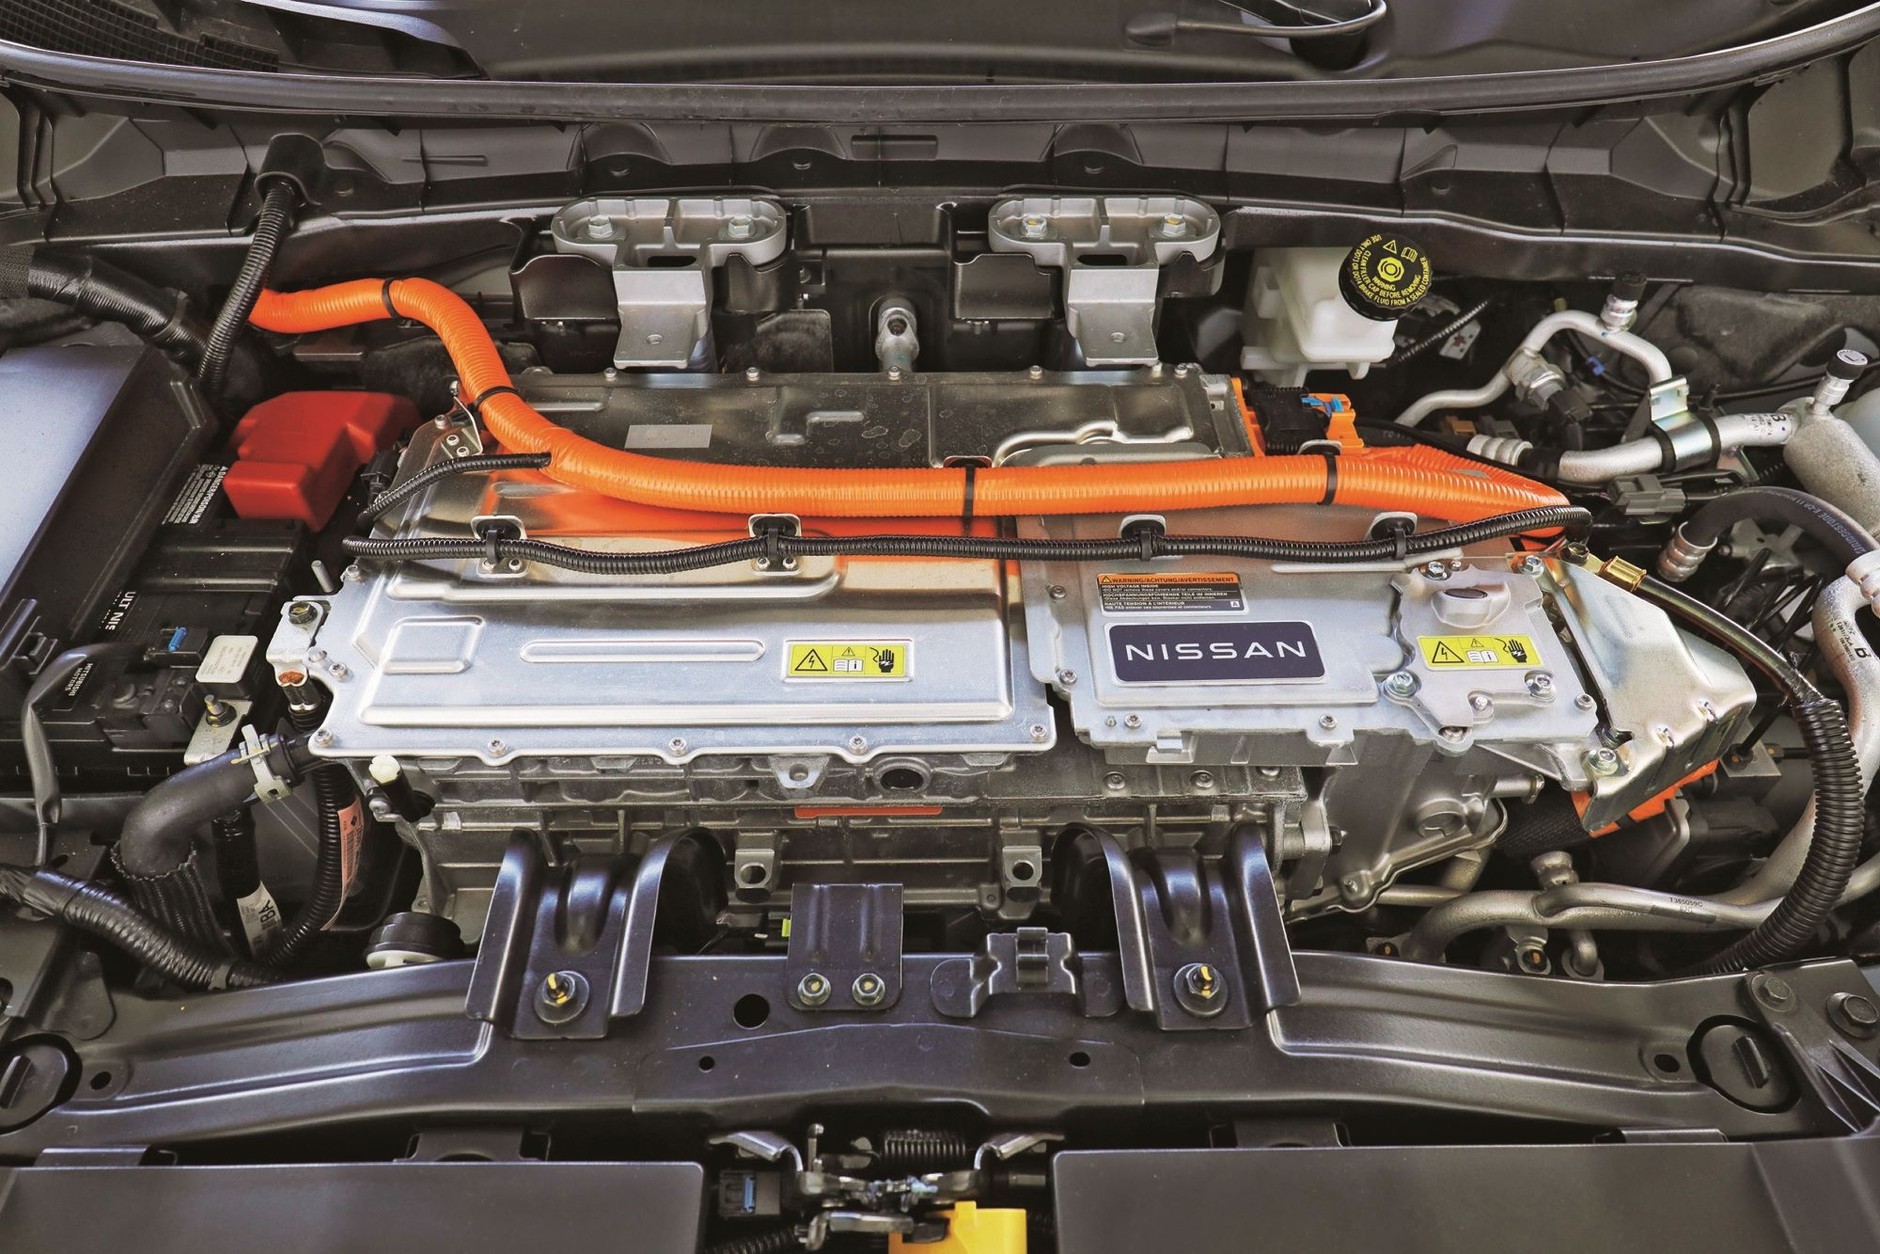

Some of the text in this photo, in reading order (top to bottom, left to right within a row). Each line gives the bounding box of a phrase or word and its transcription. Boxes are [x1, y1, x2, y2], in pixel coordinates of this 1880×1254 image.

[1368, 283, 1380, 292] CAP
[1379, 290, 1402, 298] BEFORE
[1125, 640, 1307, 662] NISSAN
[258, 899, 276, 923] BA
